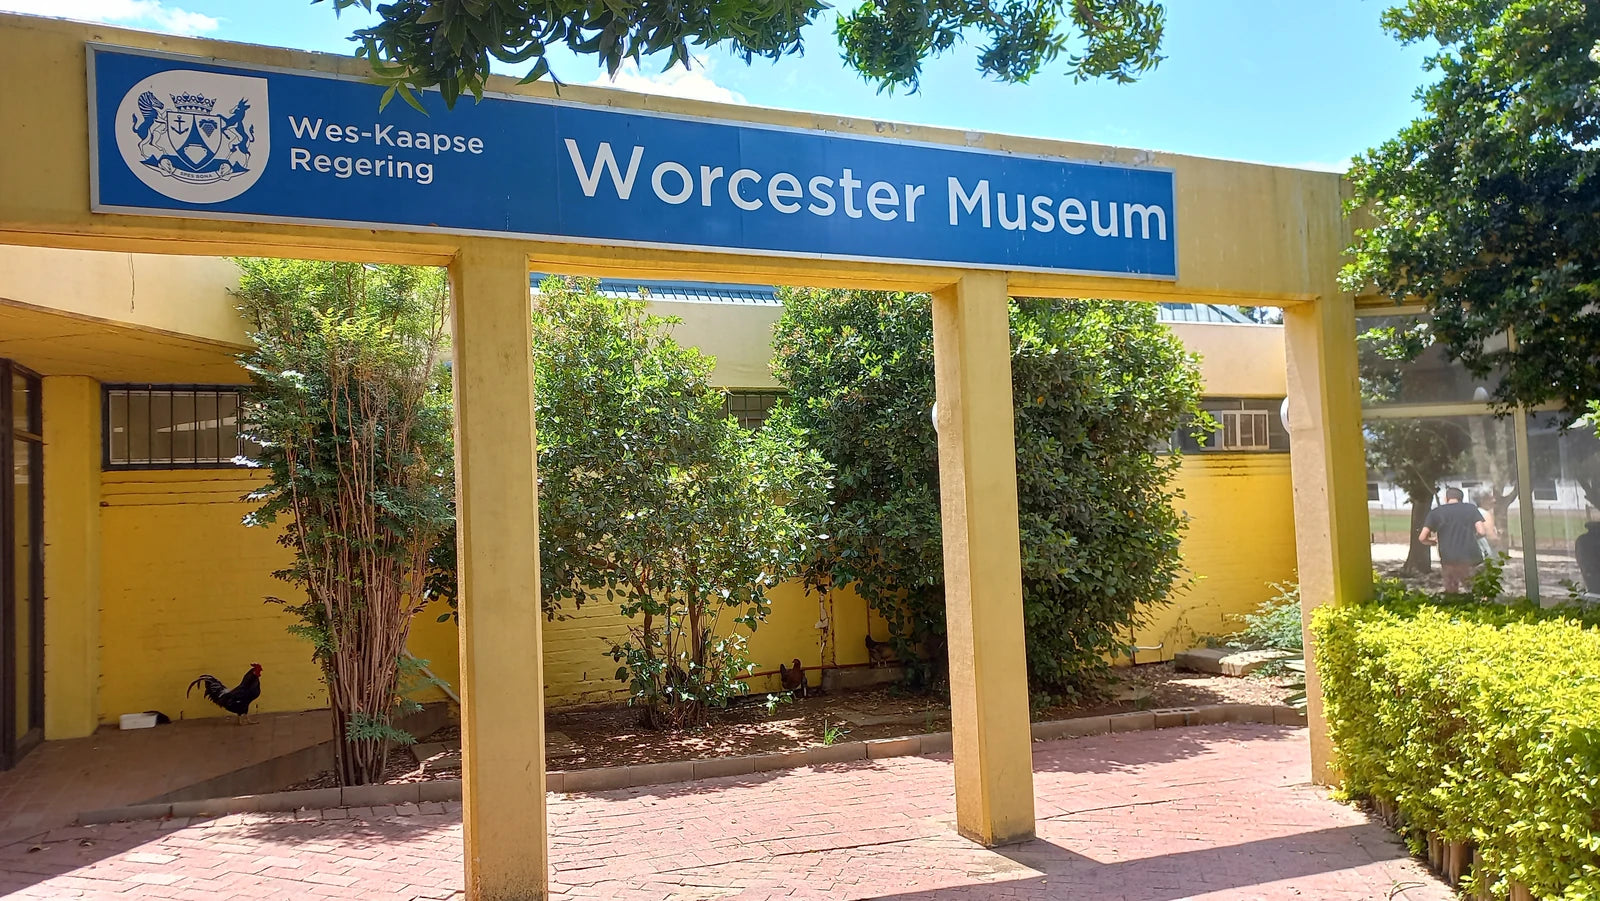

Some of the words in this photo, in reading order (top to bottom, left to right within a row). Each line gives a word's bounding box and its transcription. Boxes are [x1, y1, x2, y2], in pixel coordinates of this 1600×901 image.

[288, 115, 484, 155] Wes-Kaapse
[290, 147, 434, 185] Regering
[565, 138, 925, 225] Worcester
[947, 176, 1167, 241] Museum
